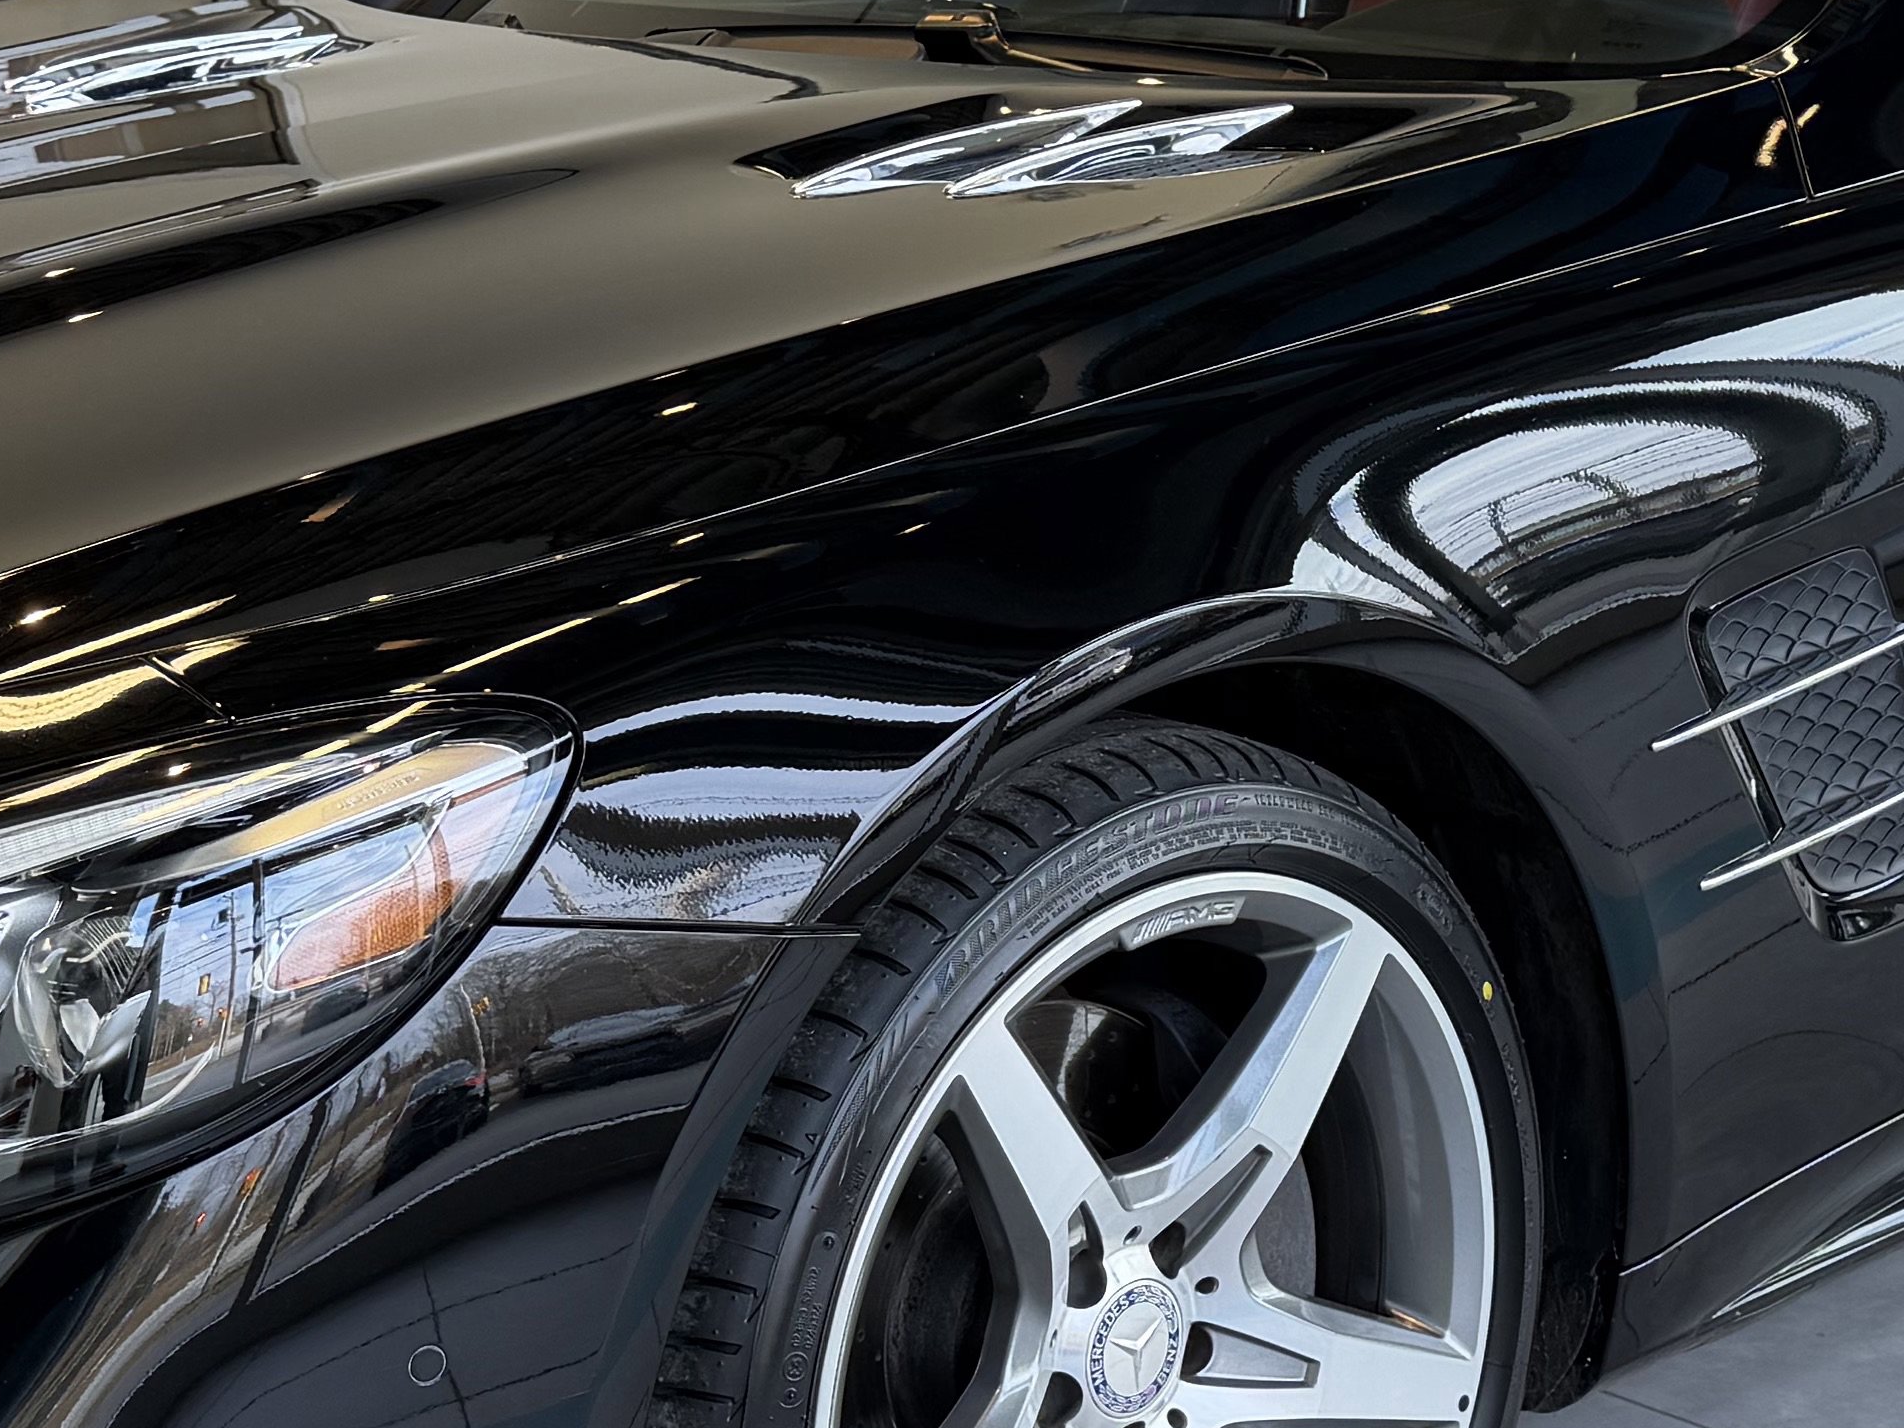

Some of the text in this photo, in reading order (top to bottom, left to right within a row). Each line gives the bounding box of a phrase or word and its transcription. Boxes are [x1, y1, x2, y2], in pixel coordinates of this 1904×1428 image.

[934, 792, 1240, 1002] BRIDGESTONE
[1090, 1295, 1130, 1386] MERCEDES
[1157, 1334, 1178, 1385] BENZ
